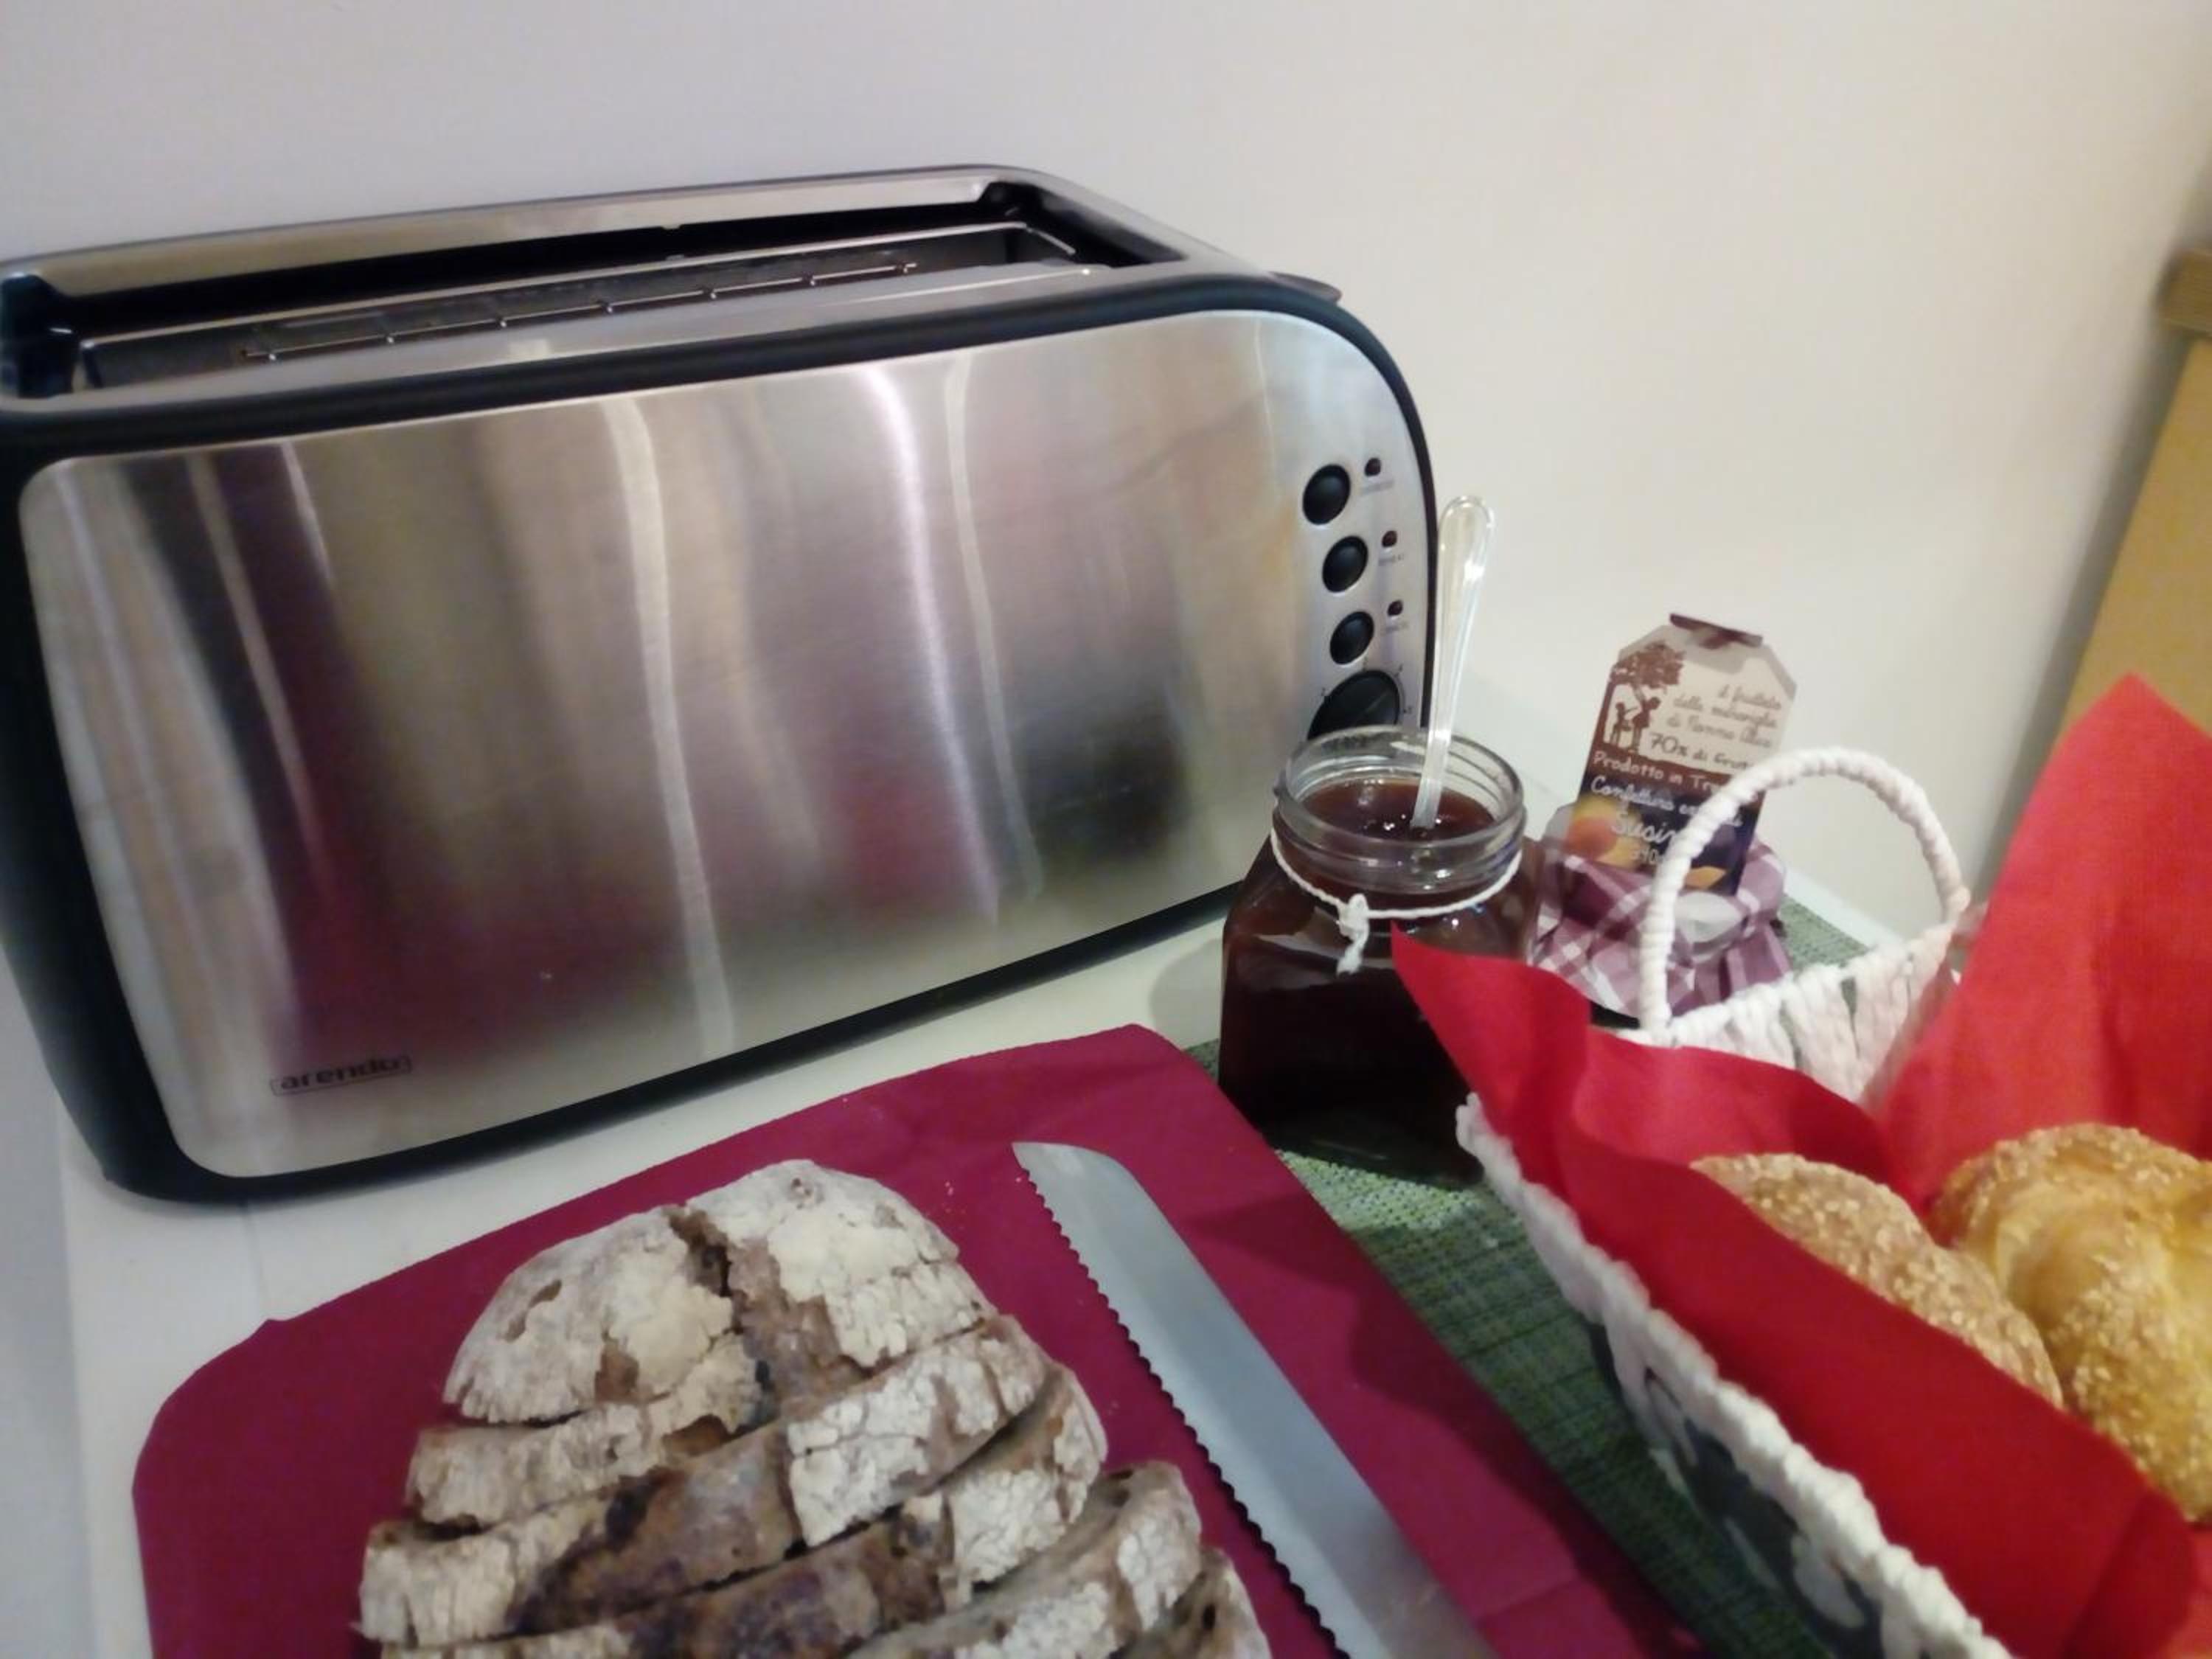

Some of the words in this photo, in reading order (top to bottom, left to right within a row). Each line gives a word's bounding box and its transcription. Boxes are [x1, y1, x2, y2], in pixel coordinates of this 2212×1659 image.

[1593, 750, 1664, 780] Prodotto
[1668, 773, 1683, 785] in
[280, 1059, 401, 1090] arendo
